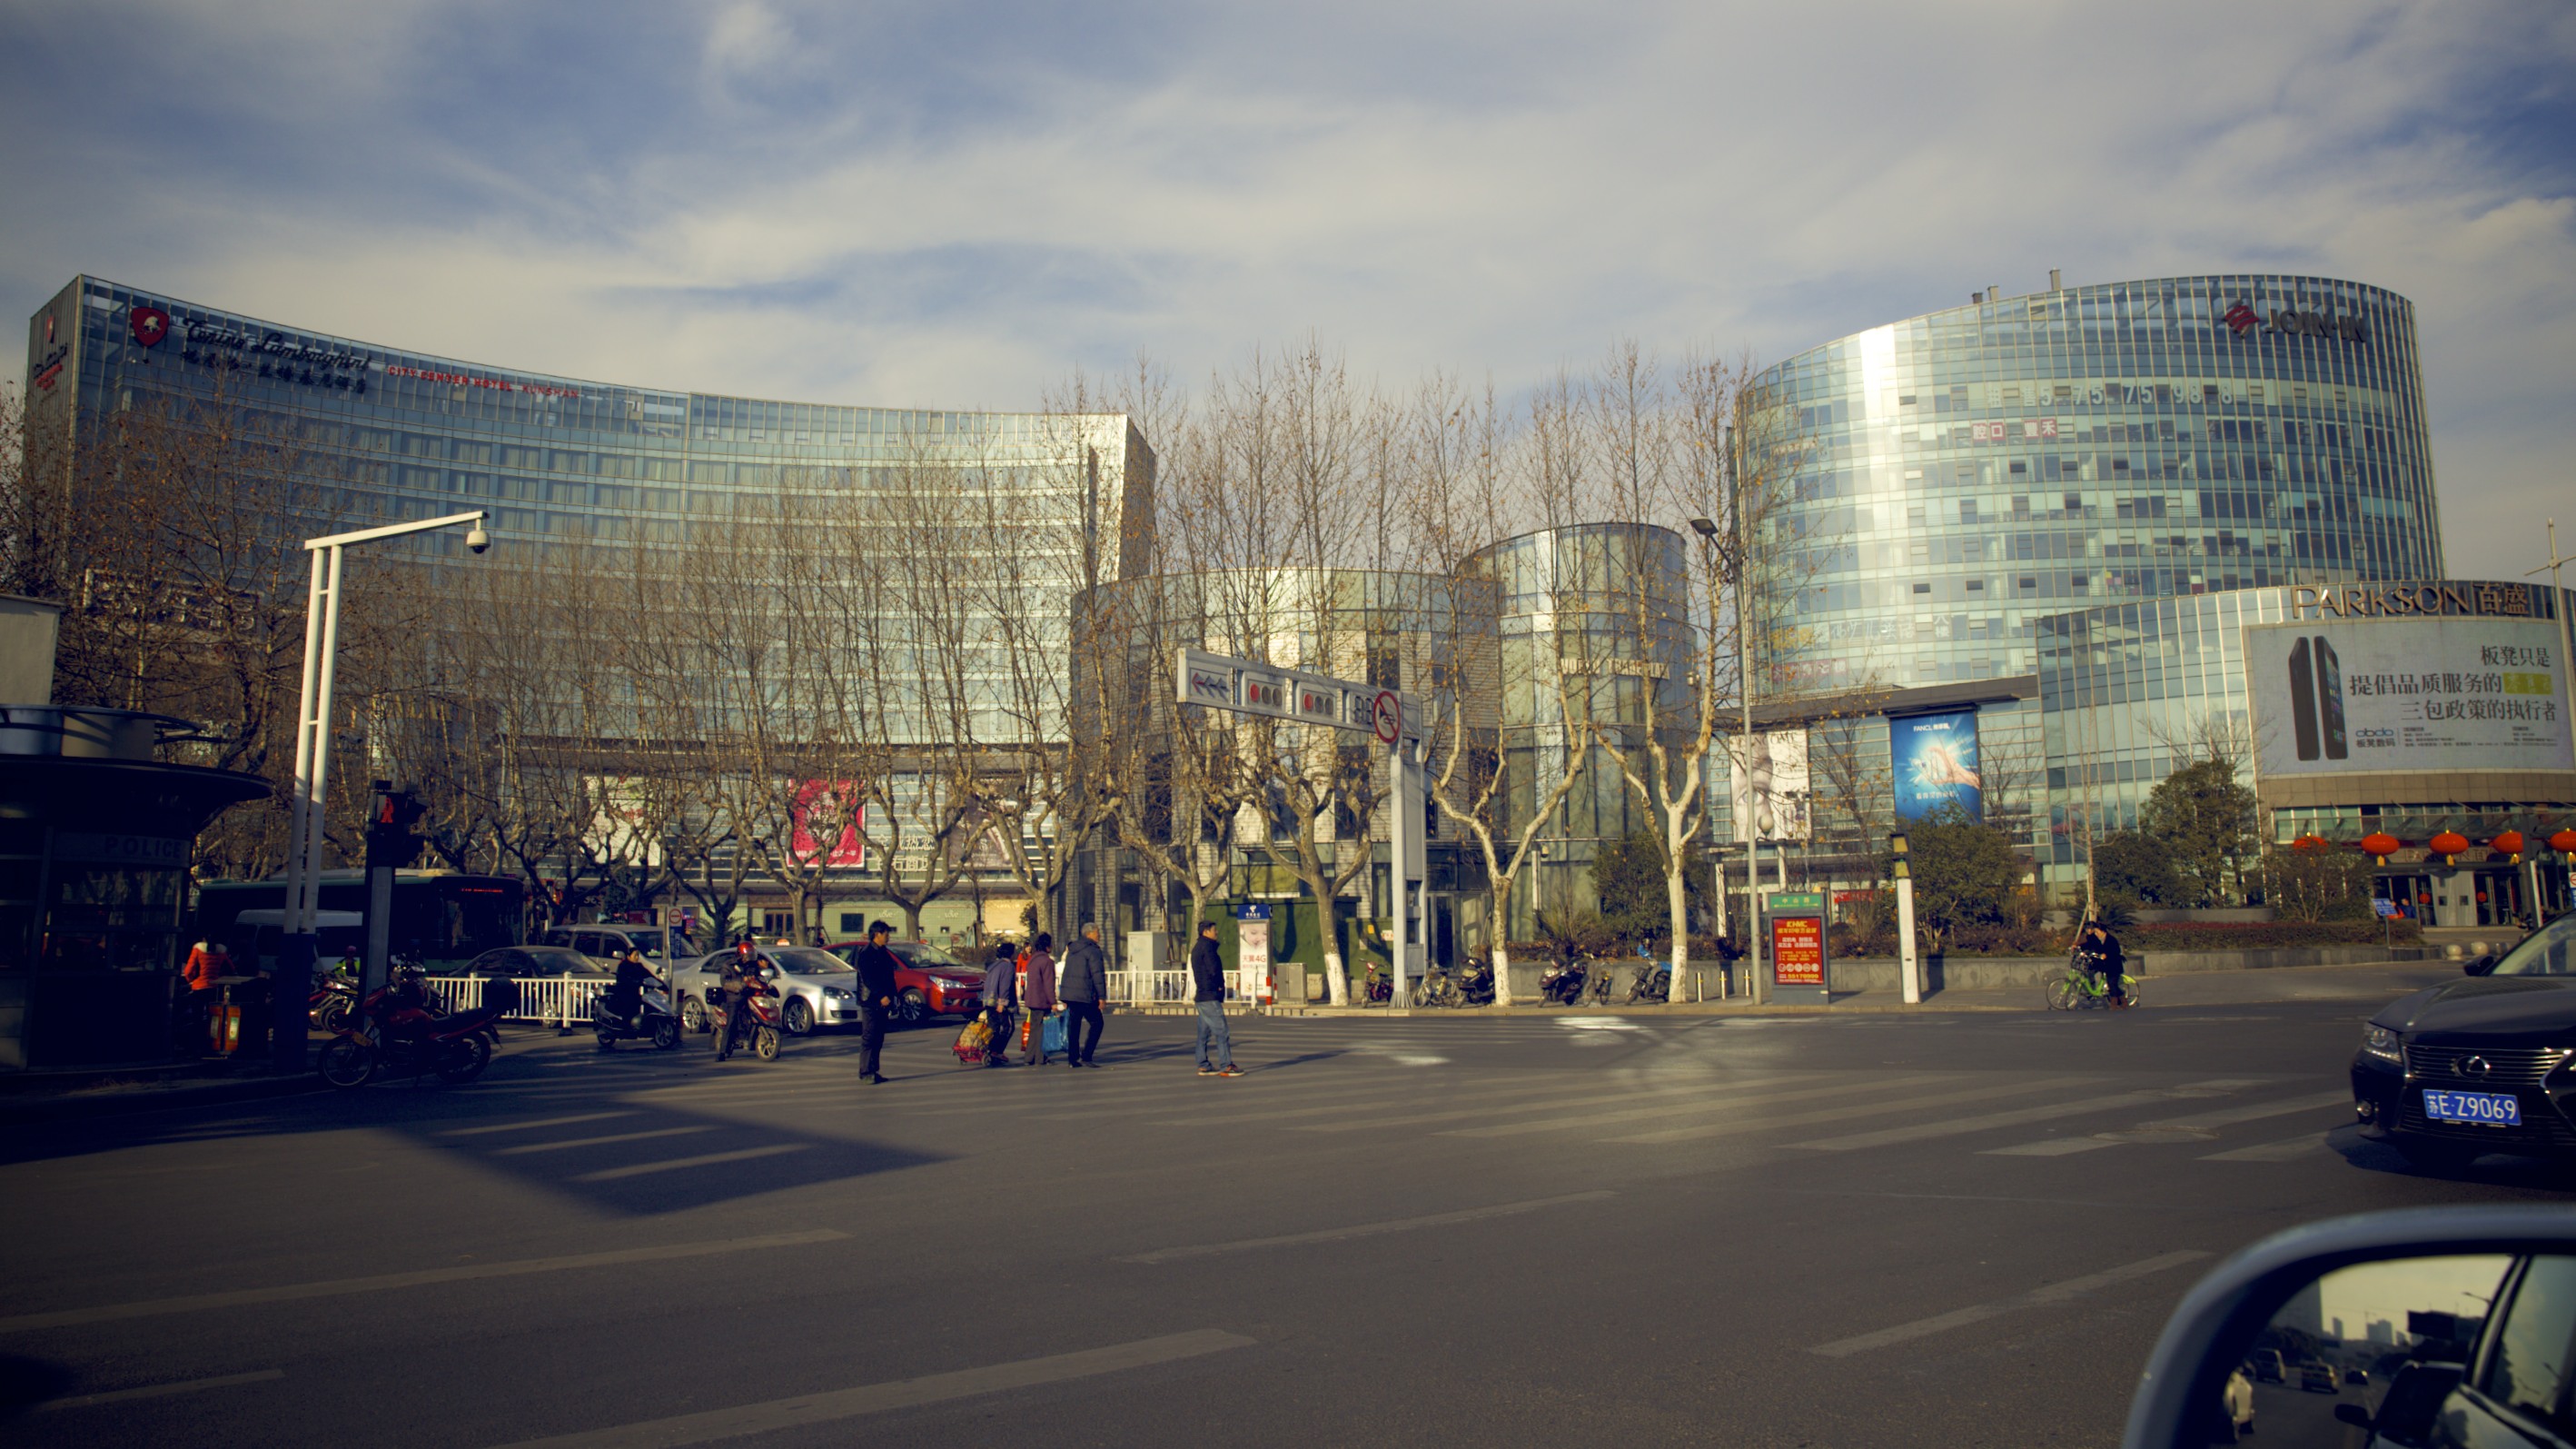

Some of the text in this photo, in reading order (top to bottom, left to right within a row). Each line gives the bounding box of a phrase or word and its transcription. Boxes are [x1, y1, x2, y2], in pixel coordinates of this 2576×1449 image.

[251, 332, 372, 371] Lamborghini
[388, 366, 579, 399] CITY CENTER HOTEL KUNSHAN
[2291, 582, 2530, 619] PARKSON 百盛
[2481, 645, 2551, 667] 板凳只是
[2401, 699, 2557, 723] 三包政策的执行者
[1913, 724, 1933, 732] FANCL
[2355, 738, 2396, 749] 板凳数码
[104, 835, 183, 858] POLICE
